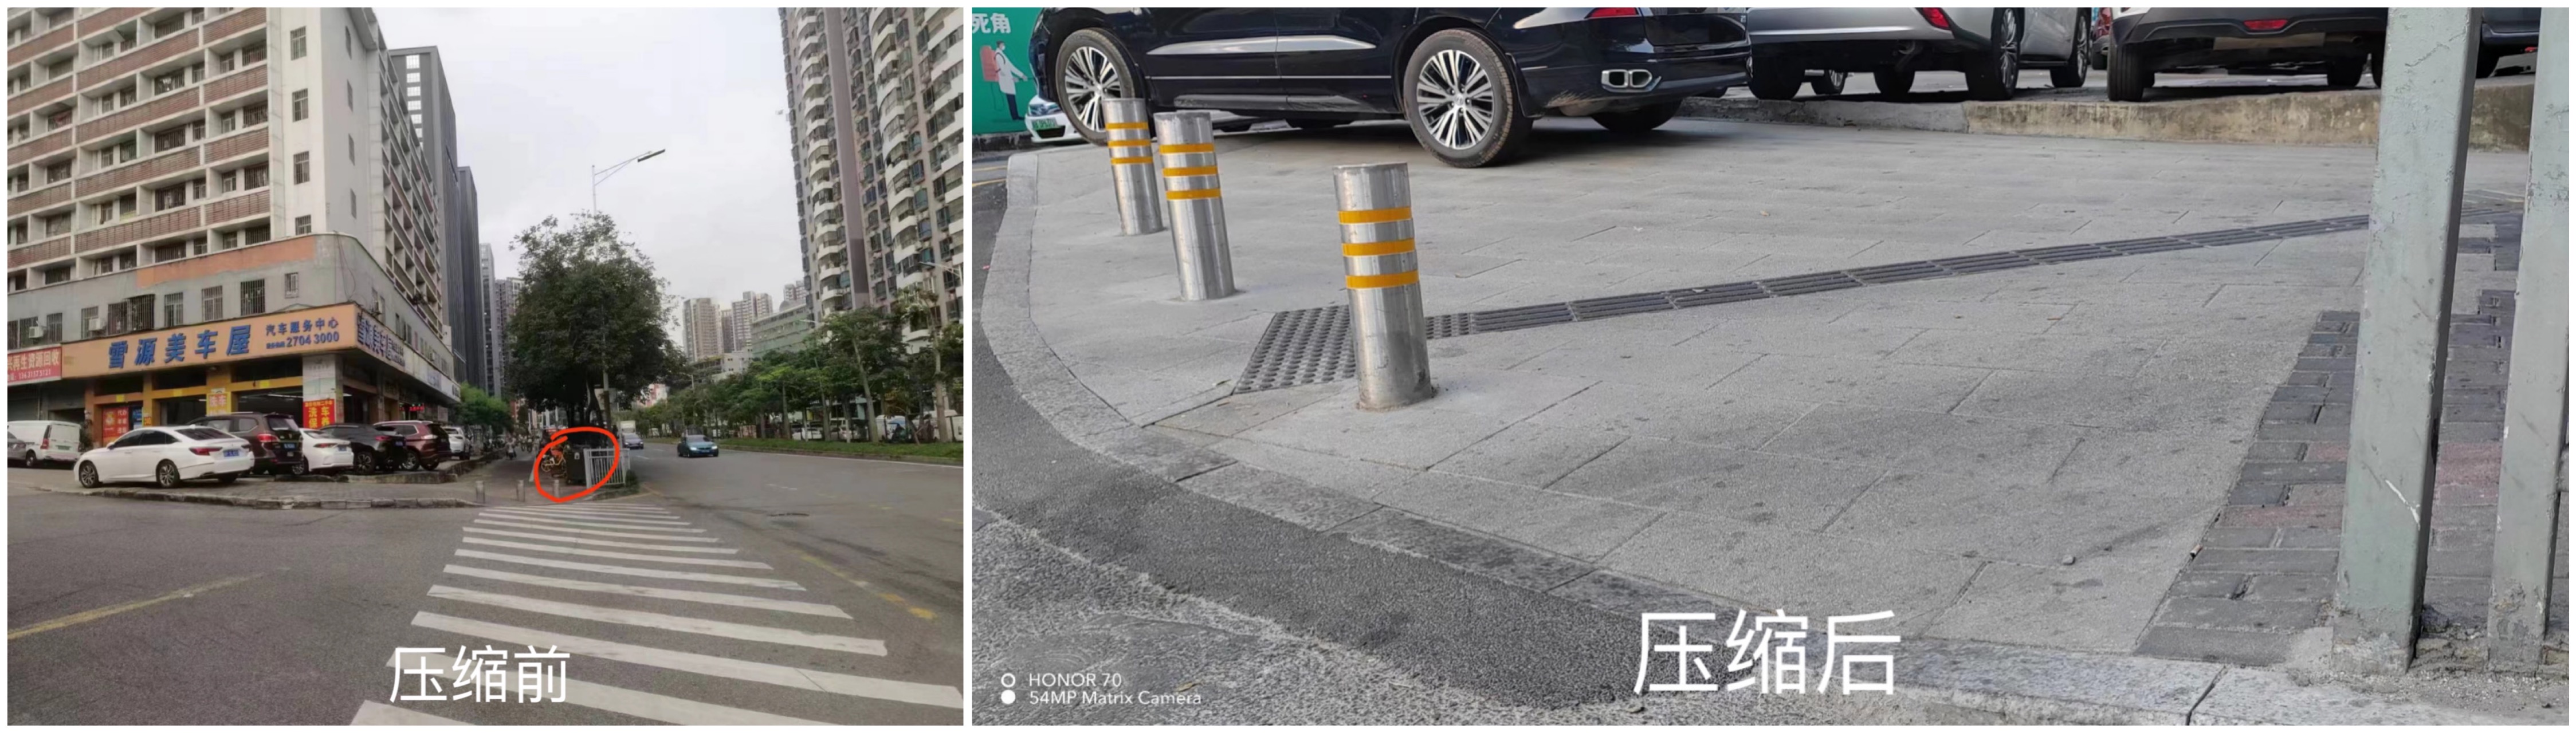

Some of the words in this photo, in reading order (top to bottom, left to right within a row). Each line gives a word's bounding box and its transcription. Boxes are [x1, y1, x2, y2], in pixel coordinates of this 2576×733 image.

[972, 13, 1011, 34] 死角
[266, 317, 339, 336] 汽车服务中心
[108, 325, 251, 369] 雪源美车屋
[286, 335, 312, 348] 2704
[314, 331, 340, 344] 3000
[308, 407, 330, 417] 洗车
